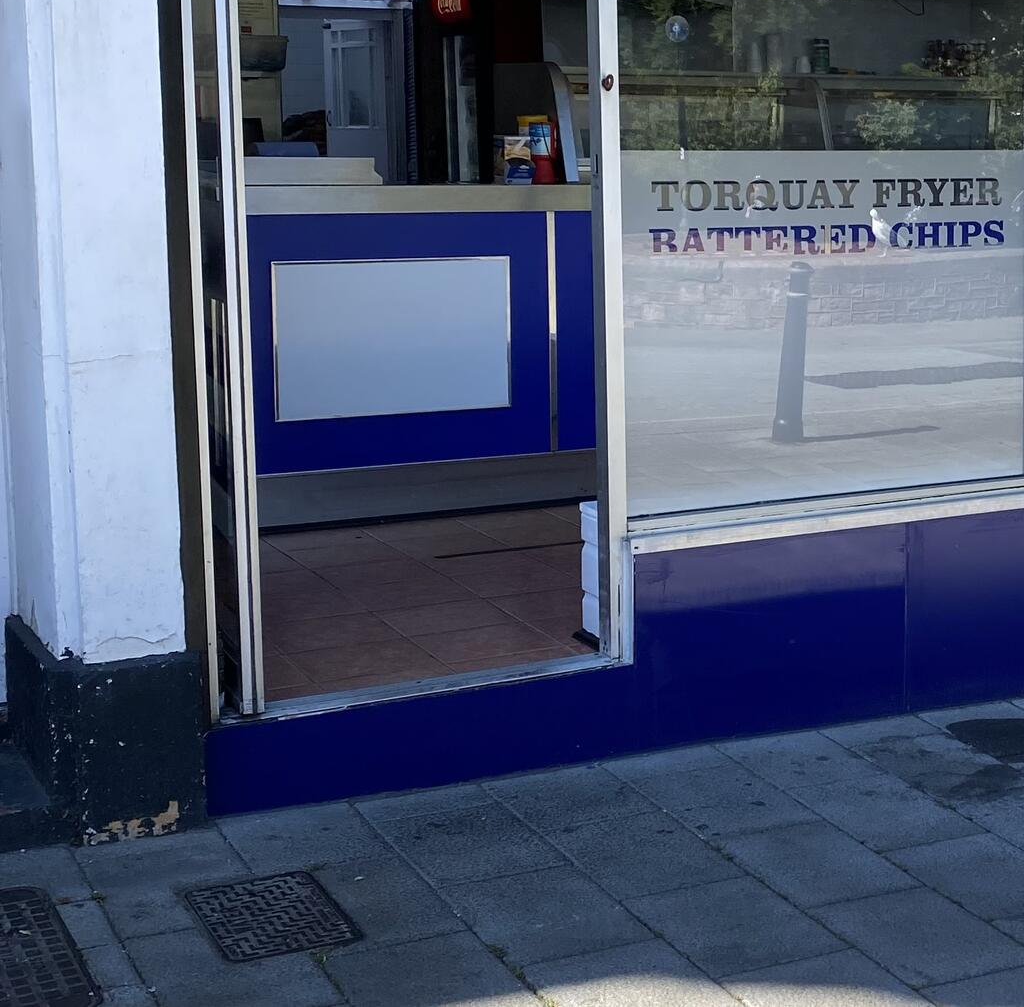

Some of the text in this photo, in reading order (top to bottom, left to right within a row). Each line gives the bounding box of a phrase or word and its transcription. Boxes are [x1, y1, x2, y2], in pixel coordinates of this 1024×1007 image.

[650, 177, 1003, 212] TORQUAY FRYER
[649, 220, 1005, 256] BATTERED CHIPS
